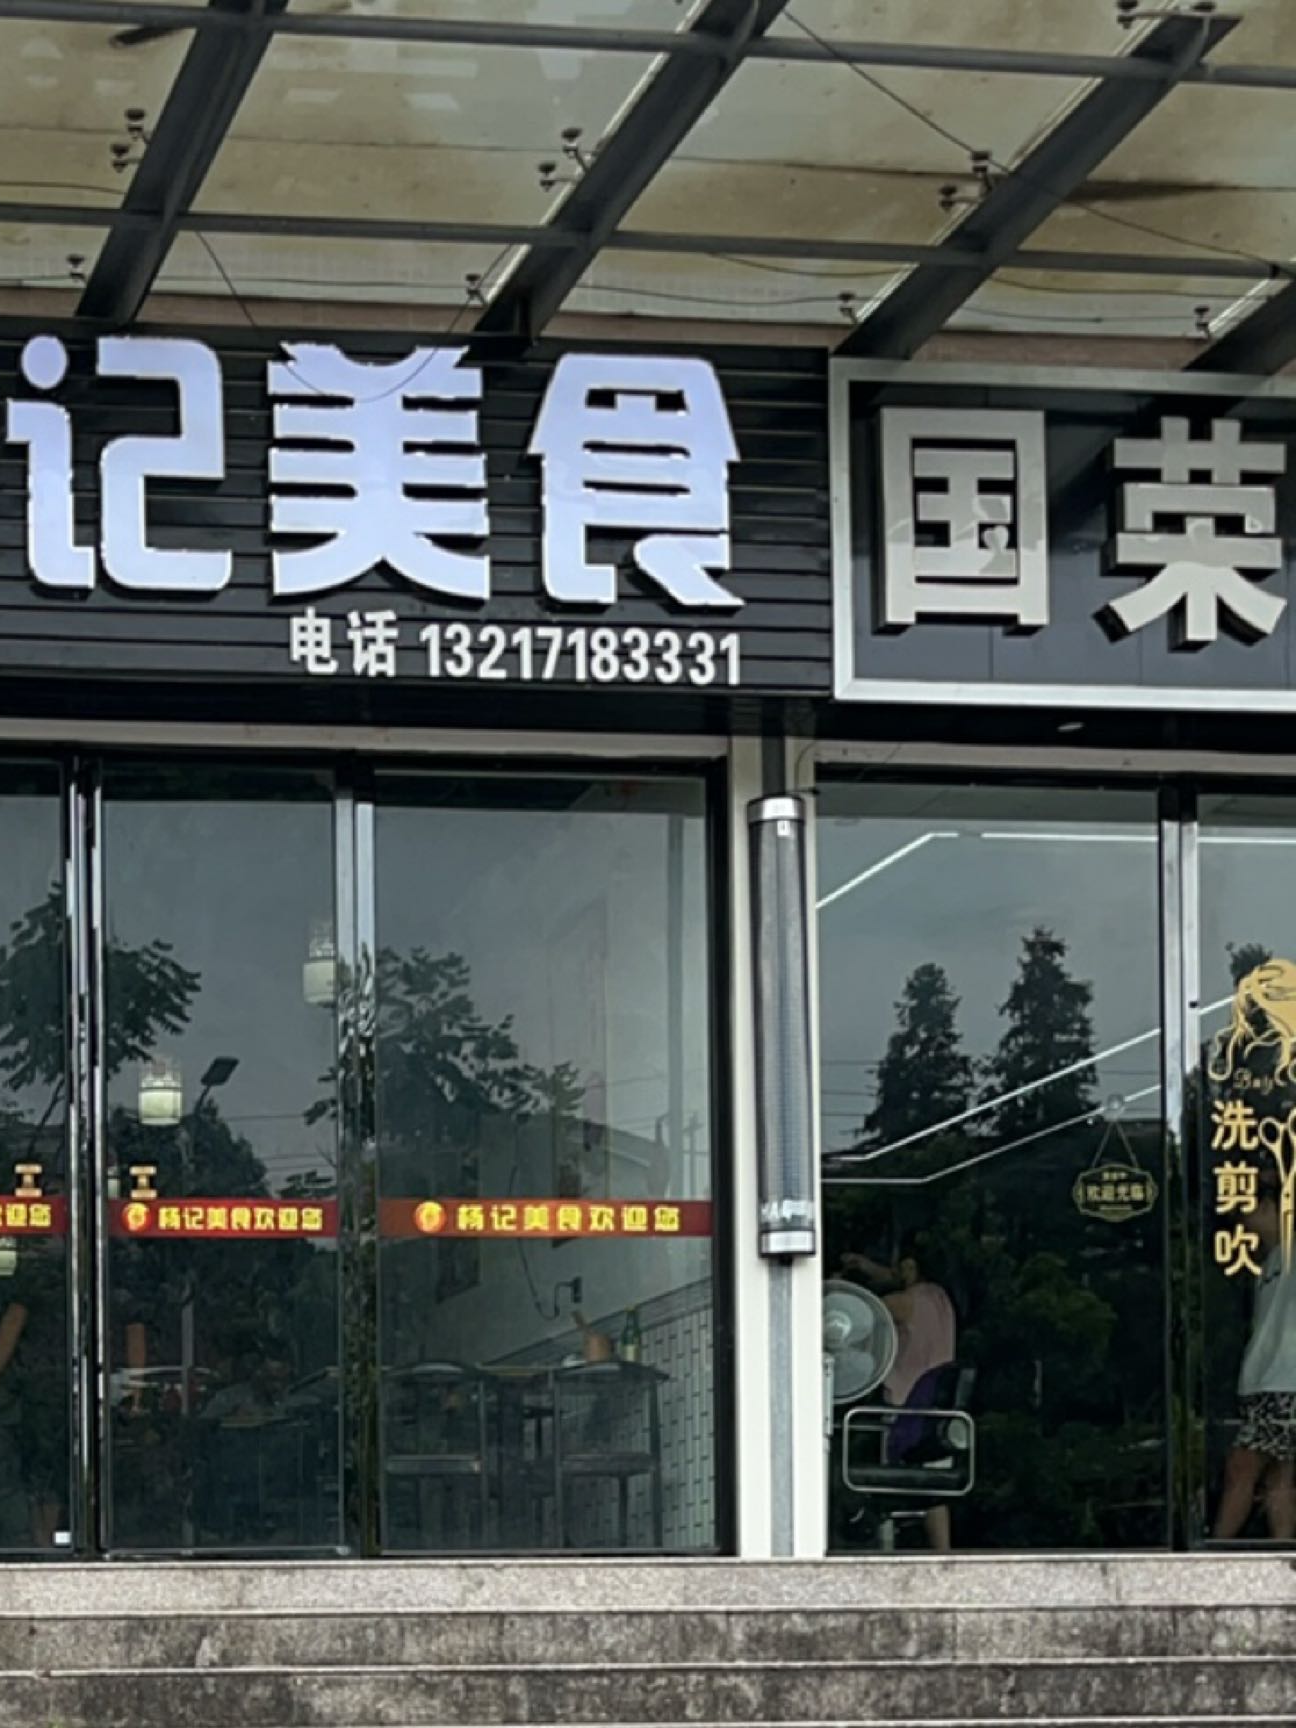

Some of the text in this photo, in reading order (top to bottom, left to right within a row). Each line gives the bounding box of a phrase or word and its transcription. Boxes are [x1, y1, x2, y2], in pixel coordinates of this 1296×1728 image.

[880, 406, 1288, 643] 国荣
[288, 607, 741, 686] 电话 13217183331
[458, 1204, 680, 1232] 杨记美食欢迎您
[1210, 1099, 1263, 1276] 洗剪吹
